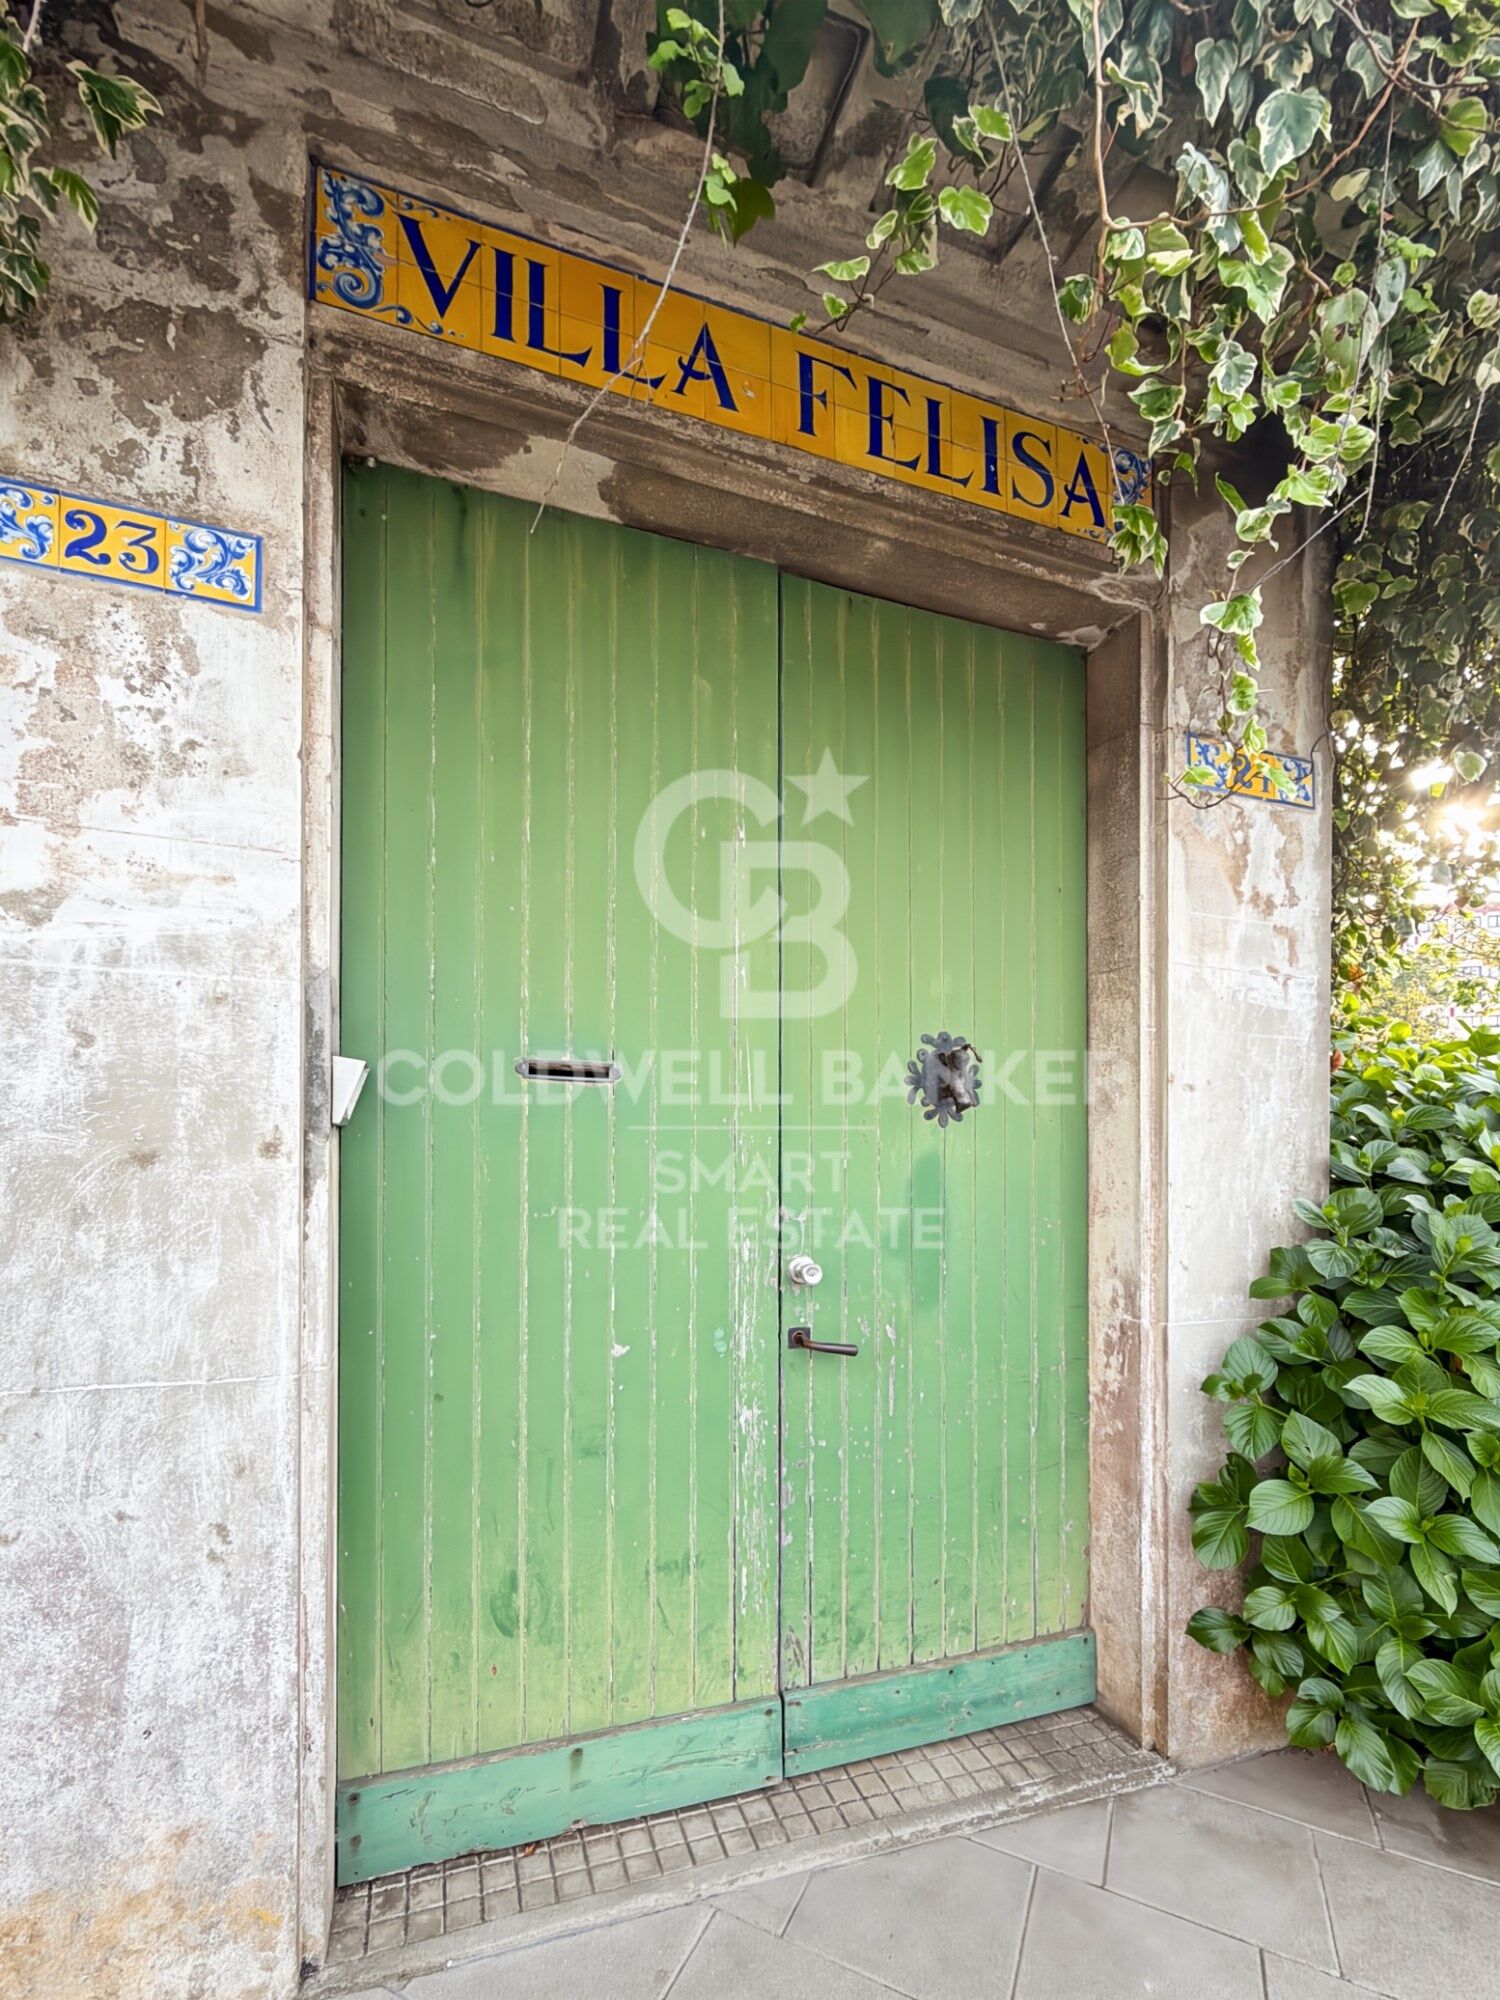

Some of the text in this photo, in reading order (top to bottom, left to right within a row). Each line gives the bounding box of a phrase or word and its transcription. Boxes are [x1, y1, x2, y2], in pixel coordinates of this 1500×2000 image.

[393, 211, 1105, 528] VILLA FELISA
[64, 508, 160, 574] 23
